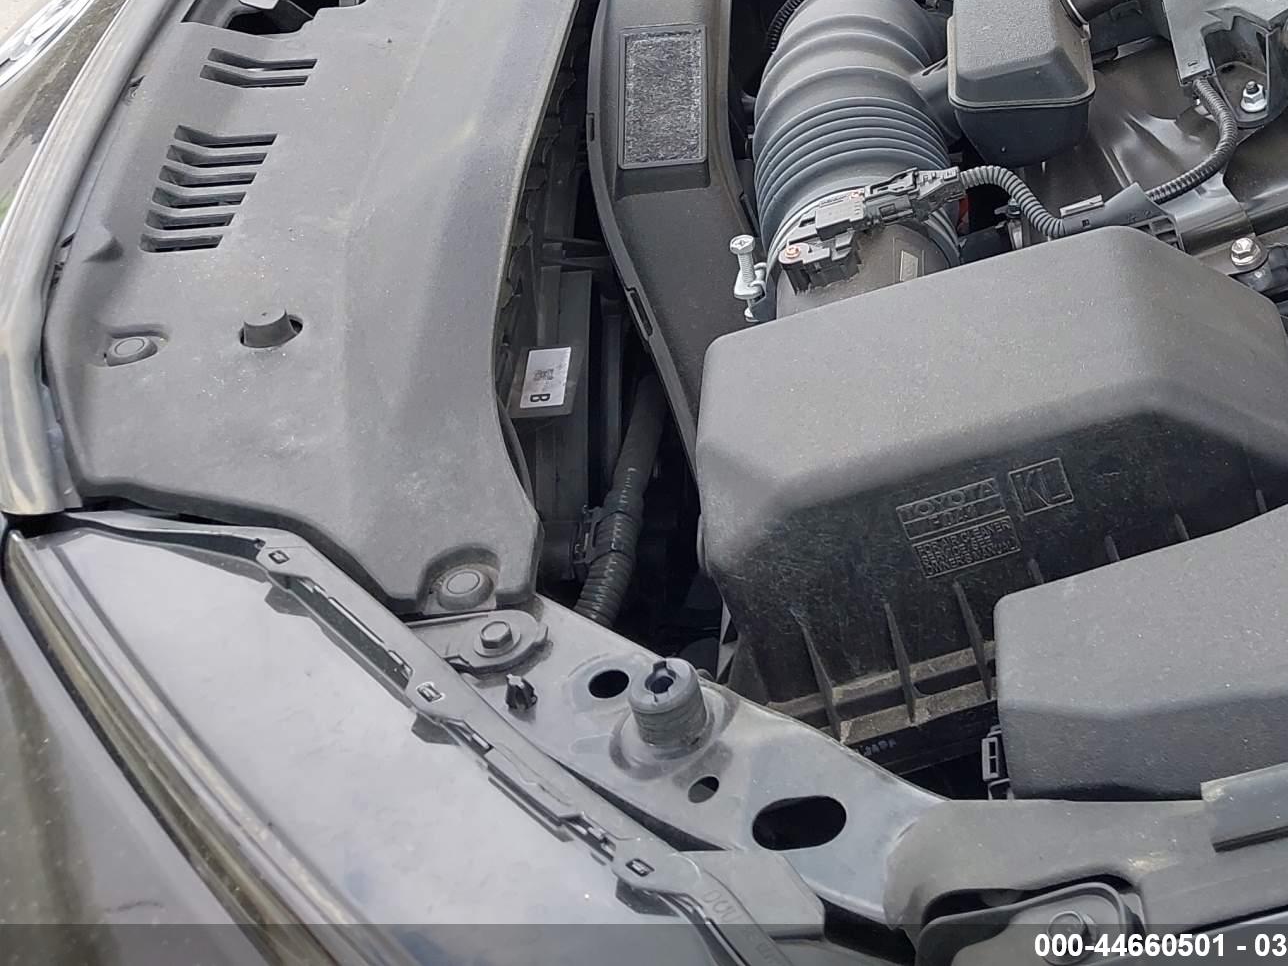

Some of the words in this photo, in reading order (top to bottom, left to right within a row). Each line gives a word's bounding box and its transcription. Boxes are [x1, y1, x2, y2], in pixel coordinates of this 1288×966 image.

[530, 394, 551, 403] B
[900, 481, 998, 520] TOYOTA
[1015, 467, 1067, 509] KL
[916, 540, 941, 556] FOR
[940, 534, 960, 548] AIR
[959, 518, 1011, 543] CLEANER
[970, 535, 993, 550] SEE
